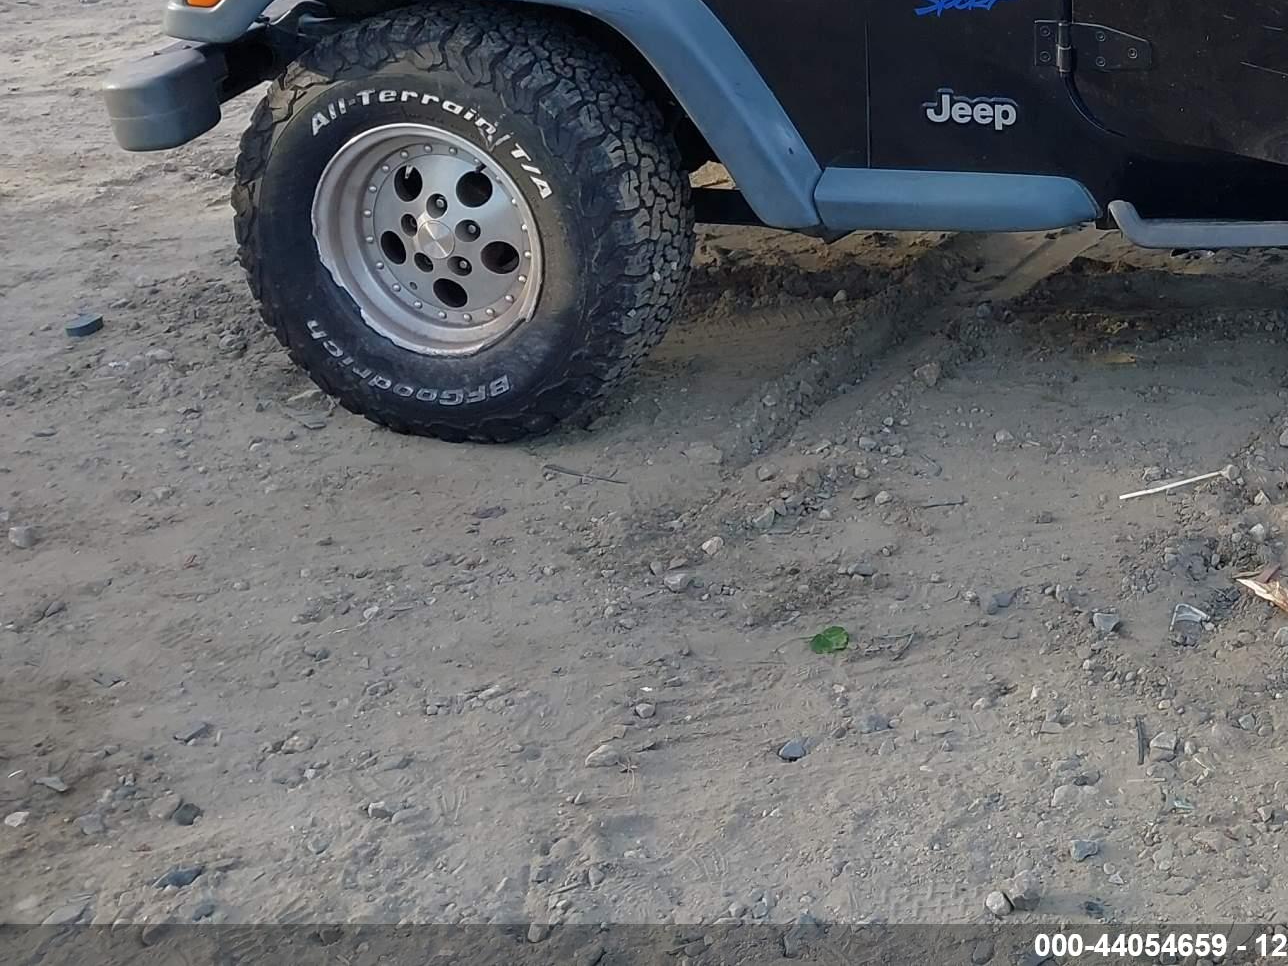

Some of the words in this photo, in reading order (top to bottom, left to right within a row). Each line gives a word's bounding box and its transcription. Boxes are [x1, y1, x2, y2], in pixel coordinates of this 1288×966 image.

[311, 89, 498, 142] All-Terrain
[510, 142, 553, 200] T/A
[926, 93, 1017, 130] Jeep
[306, 319, 512, 406] BFGoodrich
